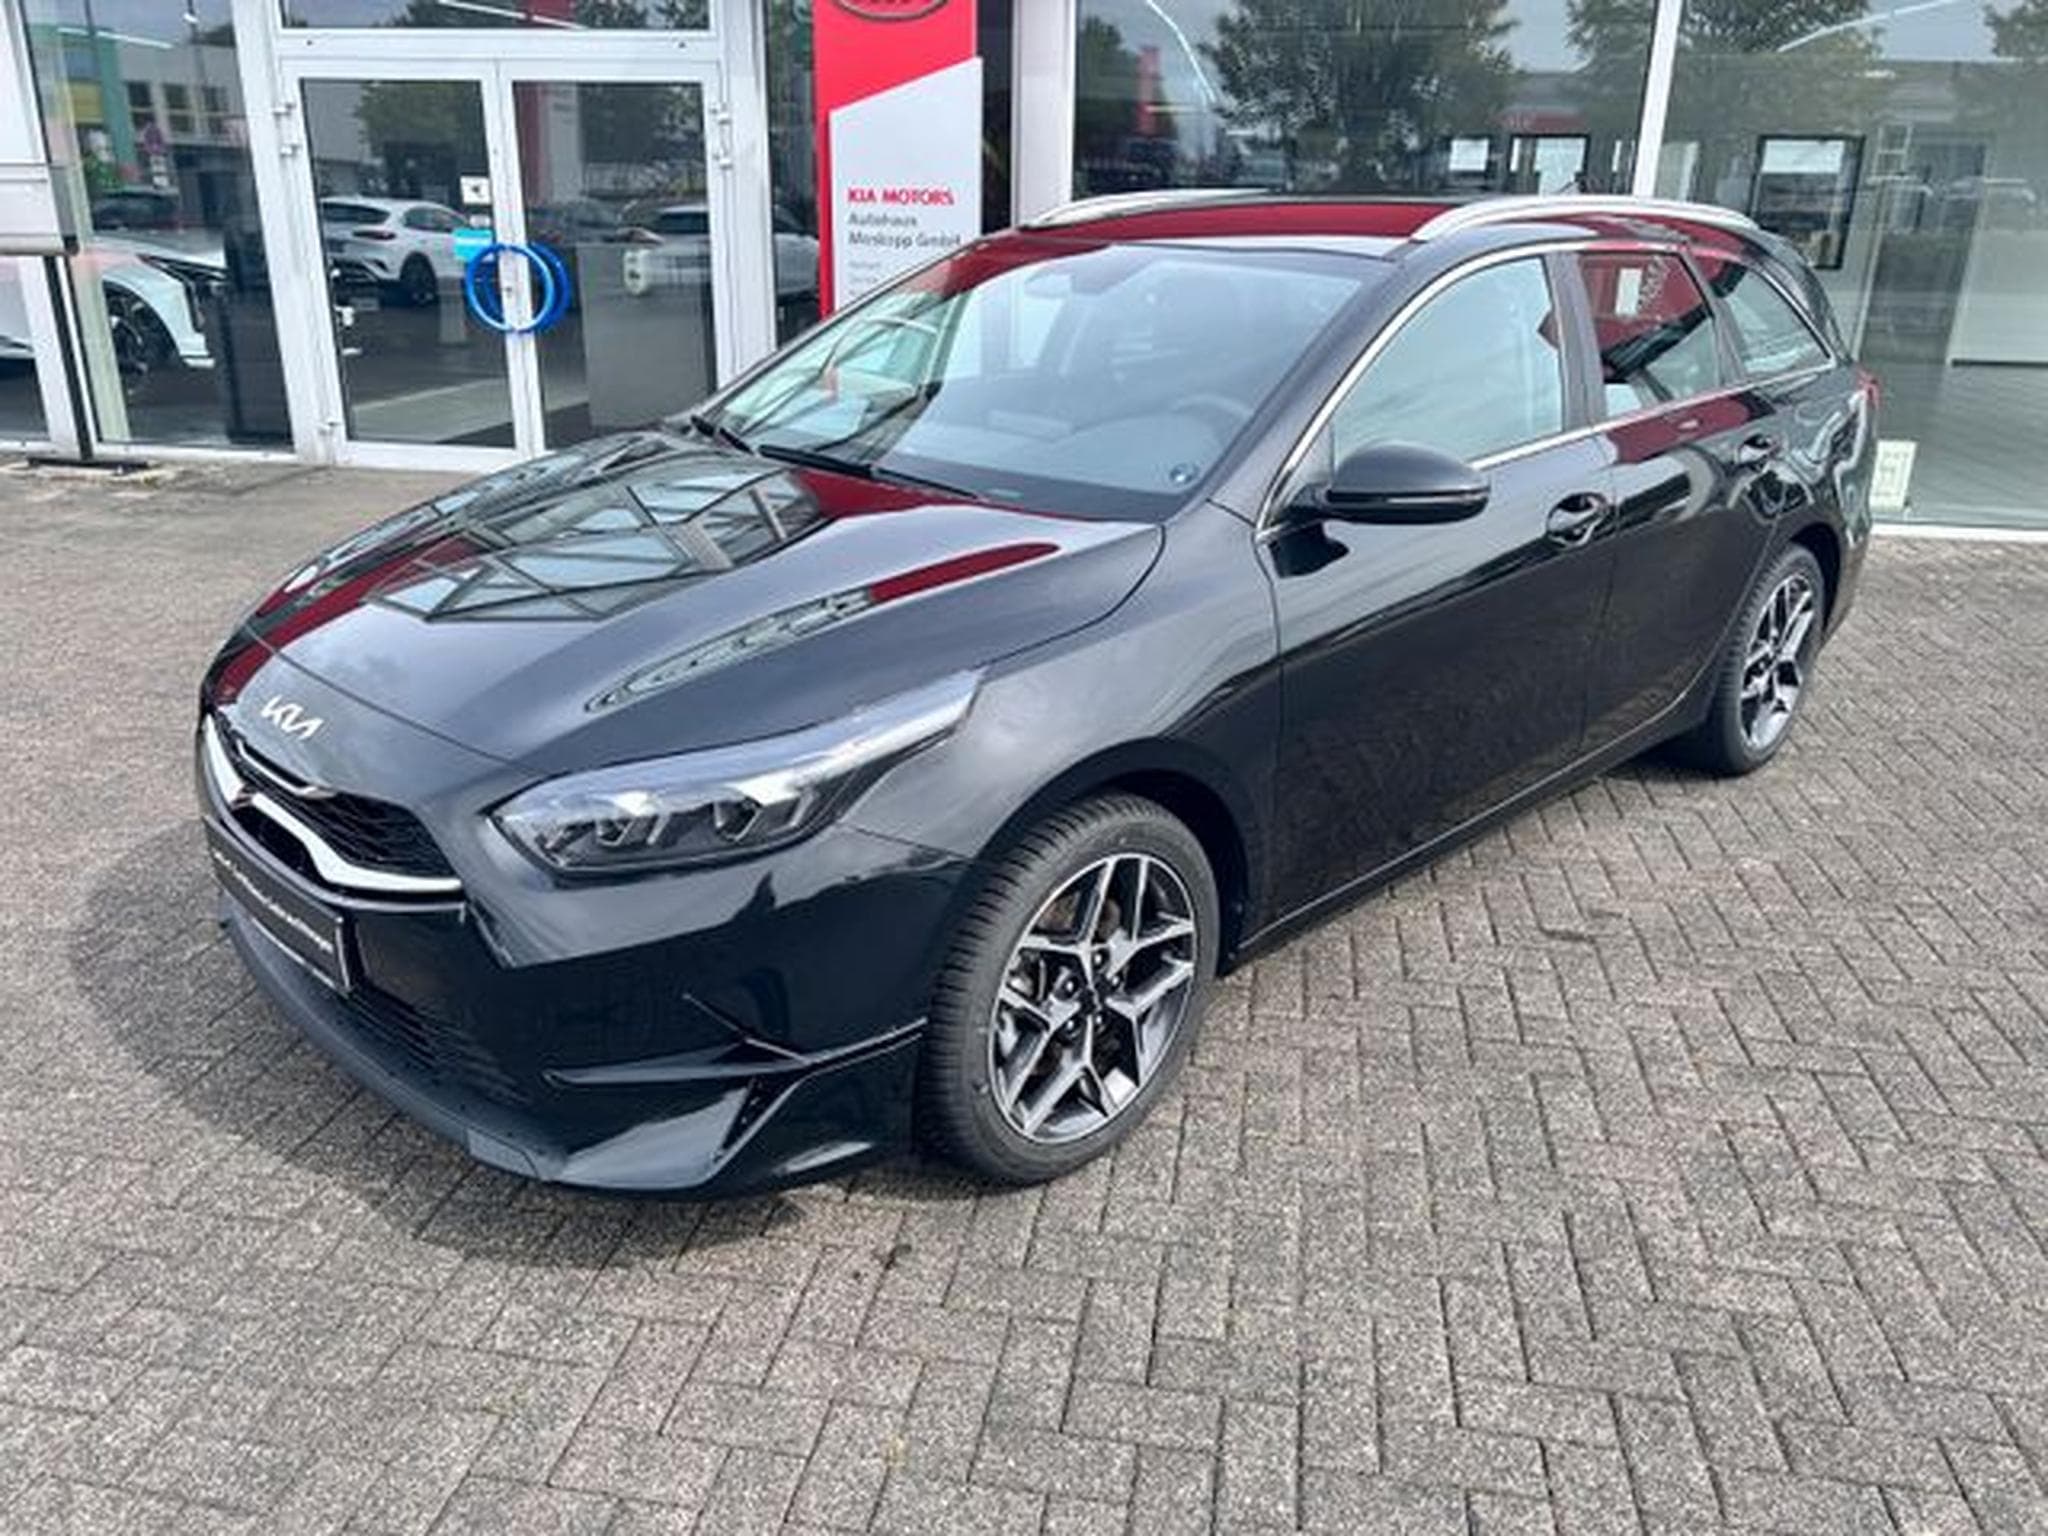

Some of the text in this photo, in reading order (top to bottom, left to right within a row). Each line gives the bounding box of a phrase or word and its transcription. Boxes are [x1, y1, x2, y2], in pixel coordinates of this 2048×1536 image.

[848, 188, 955, 206] KIA MOTORS
[260, 695, 325, 741] KIA
